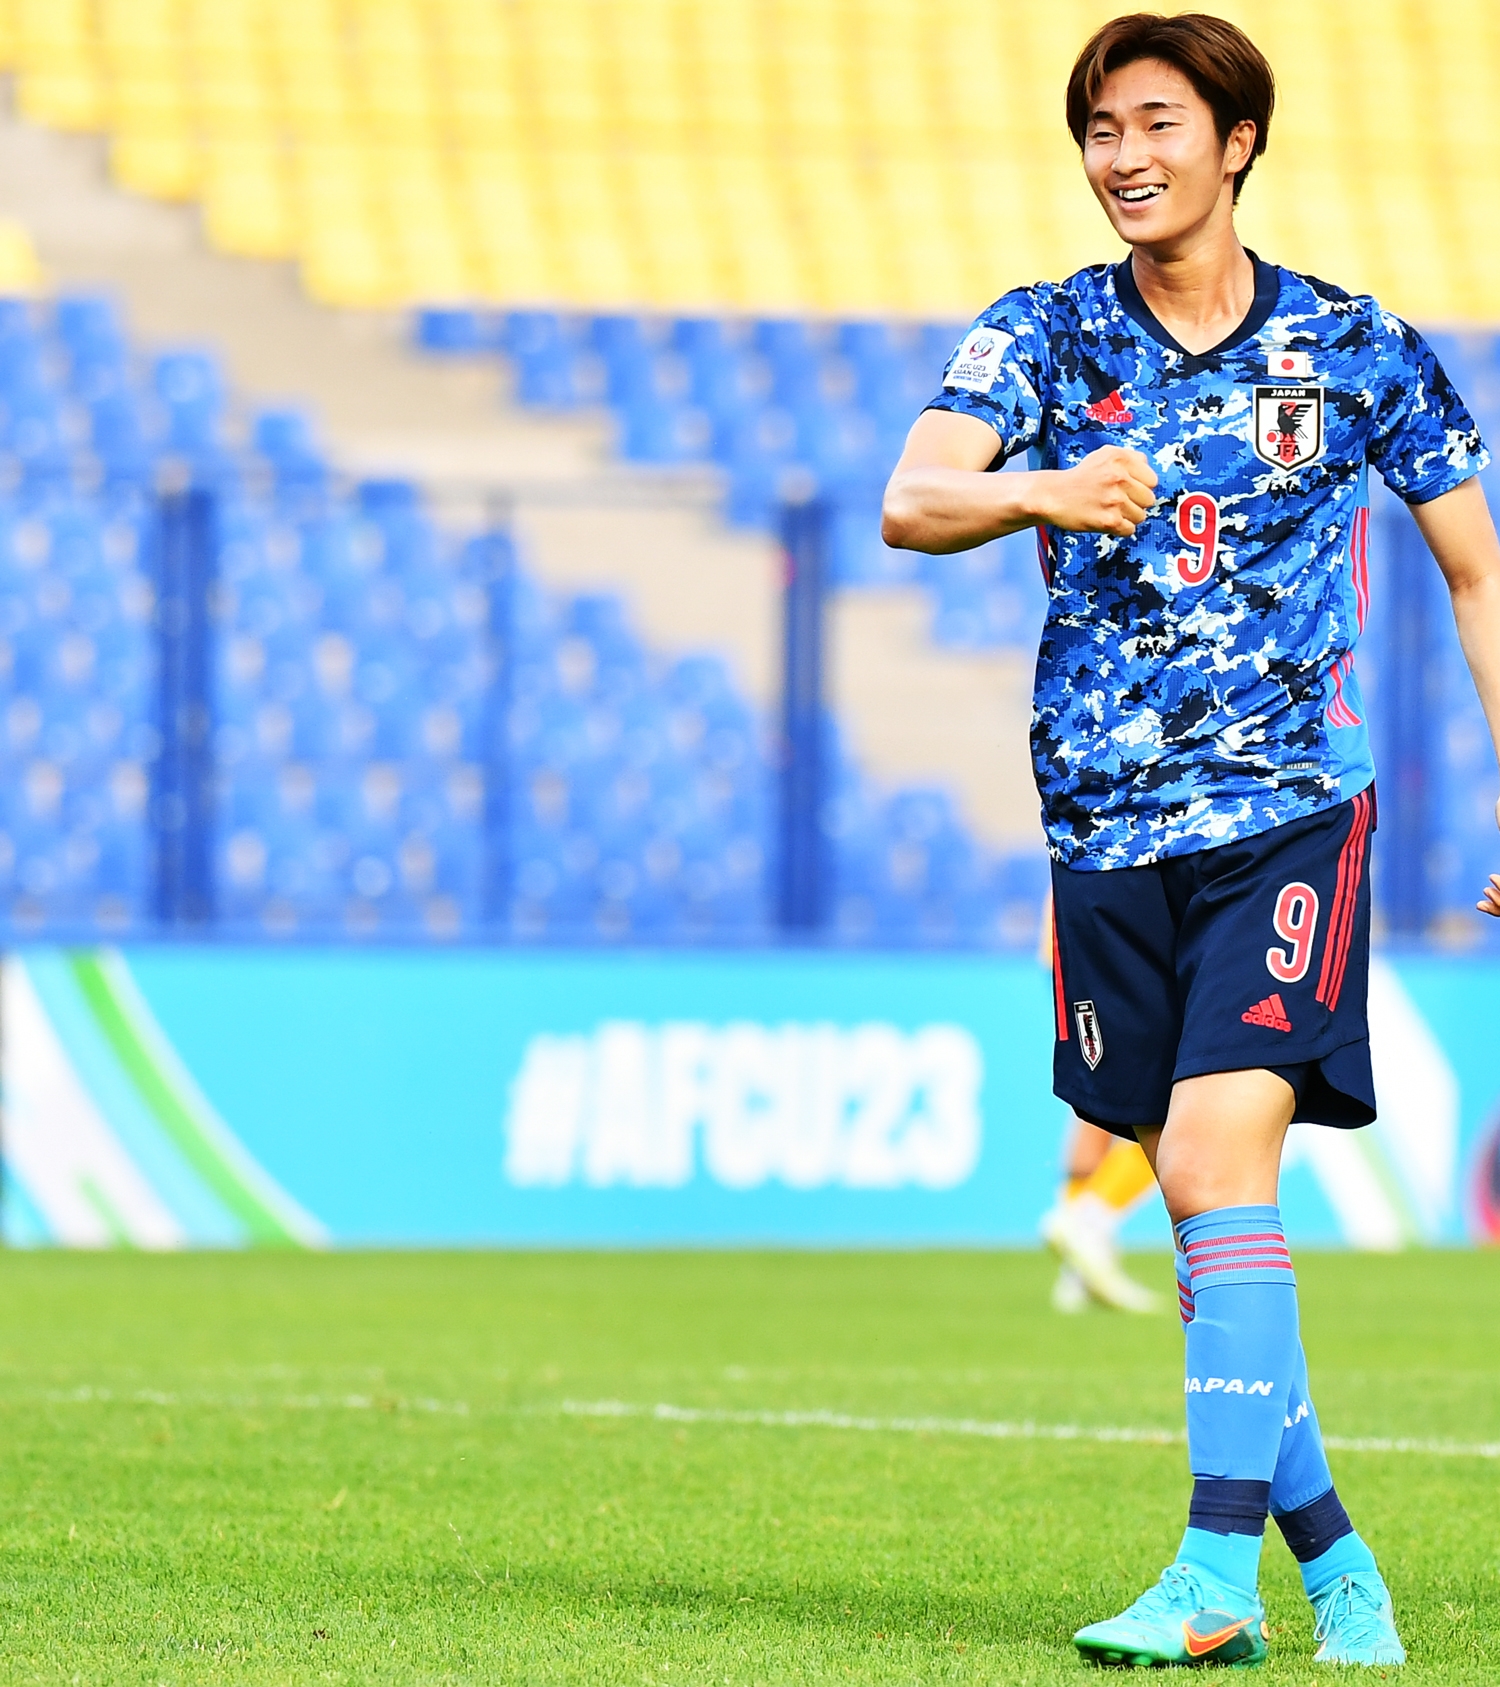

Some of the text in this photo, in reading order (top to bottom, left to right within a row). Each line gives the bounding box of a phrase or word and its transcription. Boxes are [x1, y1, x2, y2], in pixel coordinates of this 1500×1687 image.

[1270, 389, 1306, 397] JAPAN
[1085, 408, 1133, 424] adidas
[1273, 444, 1301, 456] JFA
[1176, 489, 1220, 586] 9
[1266, 882, 1319, 983] 9
[1241, 1011, 1292, 1033] adidas
[506, 1022, 983, 1188] #AFCU23
